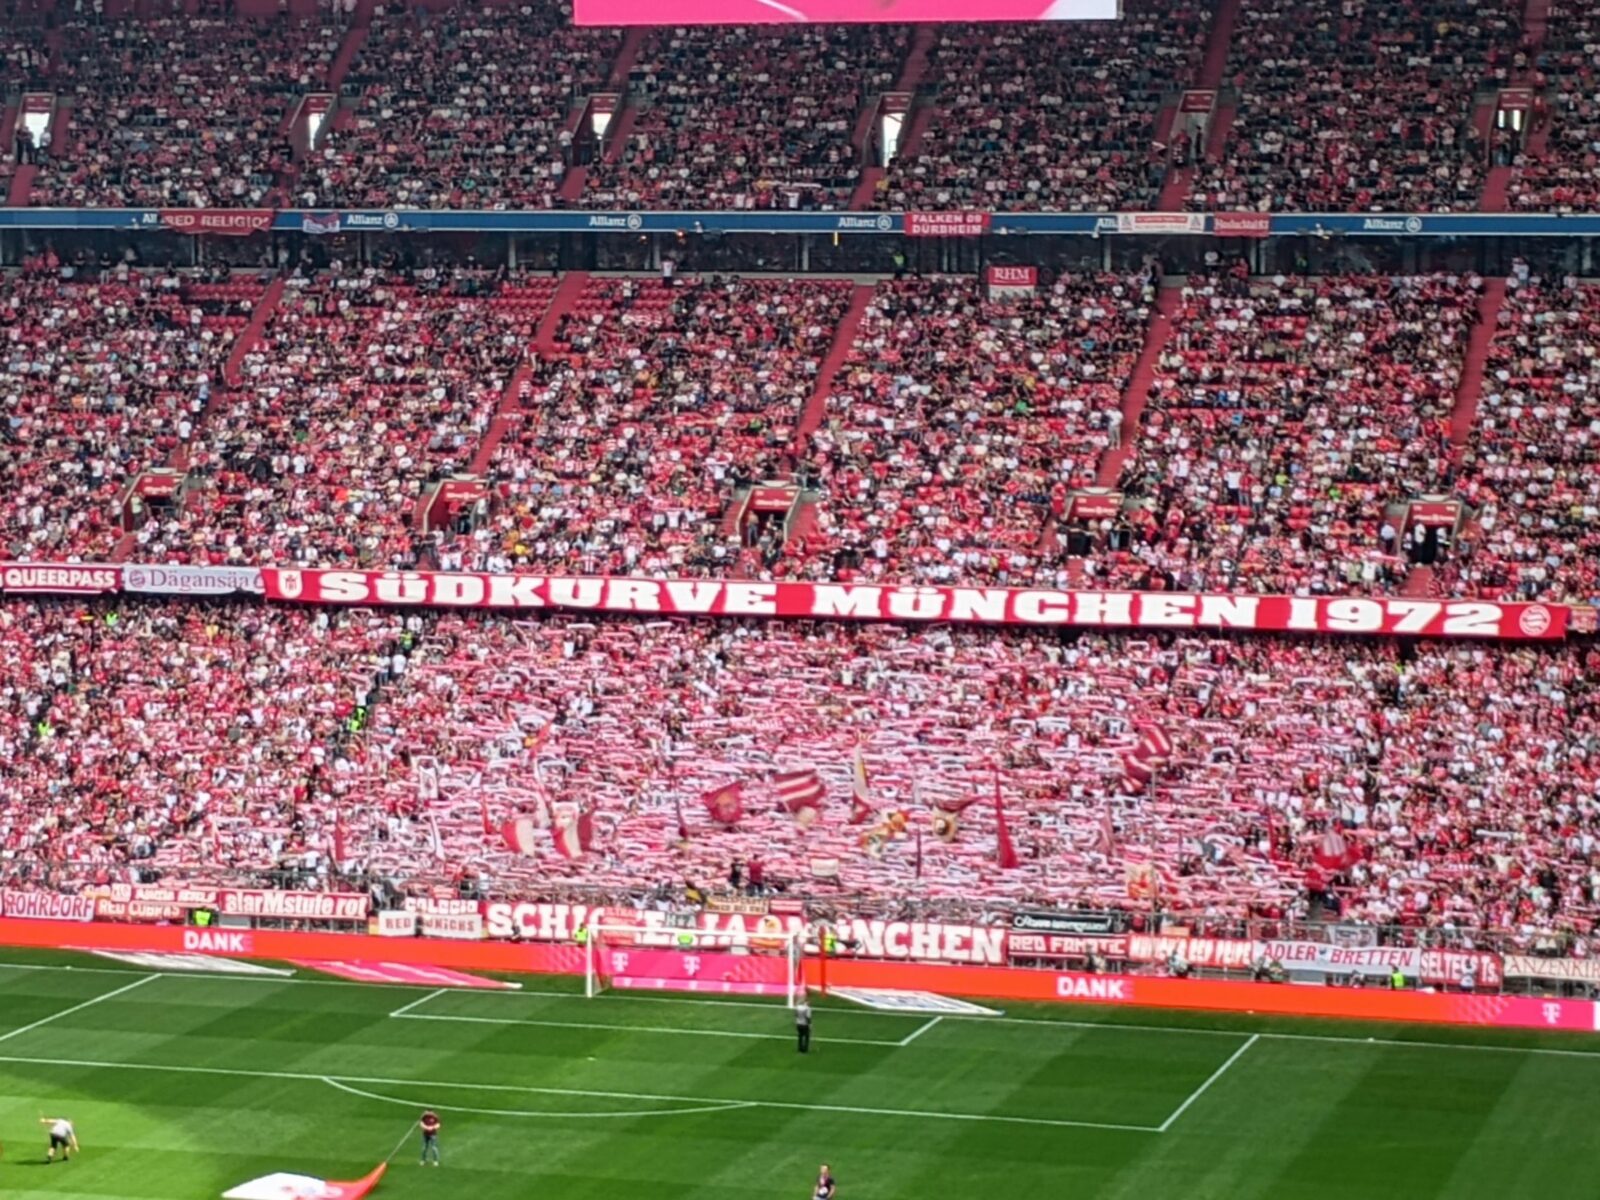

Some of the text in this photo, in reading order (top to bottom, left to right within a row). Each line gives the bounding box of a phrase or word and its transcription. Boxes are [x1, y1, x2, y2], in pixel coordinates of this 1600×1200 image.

[346, 214, 383, 225] Allianz
[588, 215, 626, 227] Allianz
[838, 216, 876, 228] Allianz
[912, 213, 963, 223] FALKEN
[1363, 218, 1404, 230] Allianz
[994, 267, 1029, 281] RHM
[5, 568, 116, 587] QUEERPASS
[318, 571, 1502, 636] SÜDKURVE MÜNCHEN 1972
[487, 903, 747, 945] SCHIEIA
[1262, 941, 1317, 962] ADLER
[1330, 948, 1413, 967] BRETTEN
